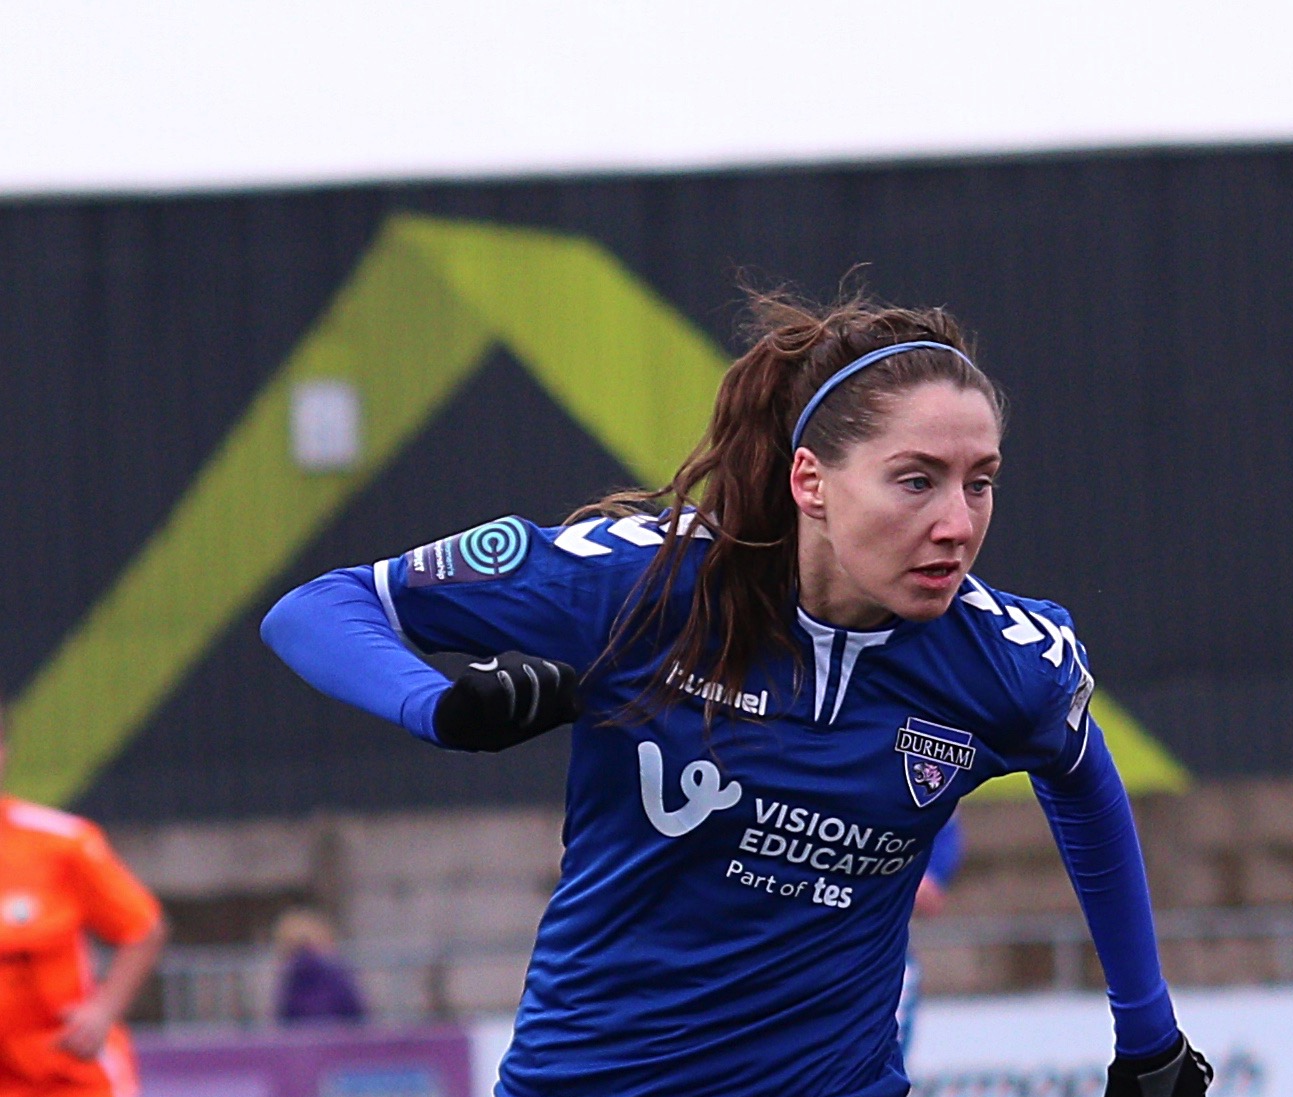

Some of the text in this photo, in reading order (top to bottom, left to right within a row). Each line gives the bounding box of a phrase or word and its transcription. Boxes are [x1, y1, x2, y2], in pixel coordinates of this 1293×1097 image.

[900, 733, 970, 767] DURHAM
[755, 798, 917, 854] VISION for
[725, 859, 854, 909] Part of tes
